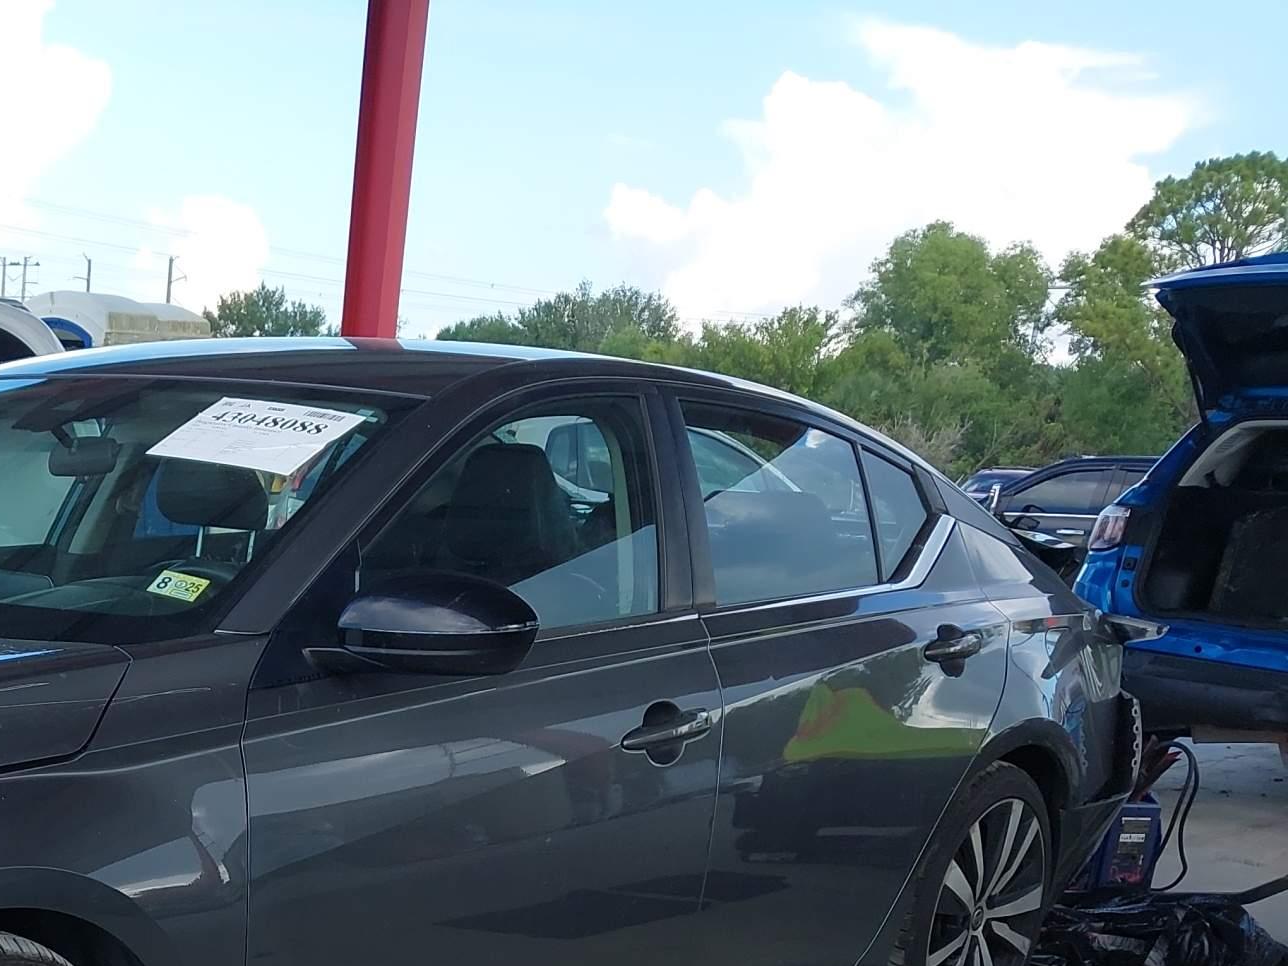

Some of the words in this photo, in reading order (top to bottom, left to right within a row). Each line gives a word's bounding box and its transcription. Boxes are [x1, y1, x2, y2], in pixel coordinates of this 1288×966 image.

[211, 411, 329, 436] 43048088
[156, 576, 173, 590] 8
[184, 582, 204, 594] 25
